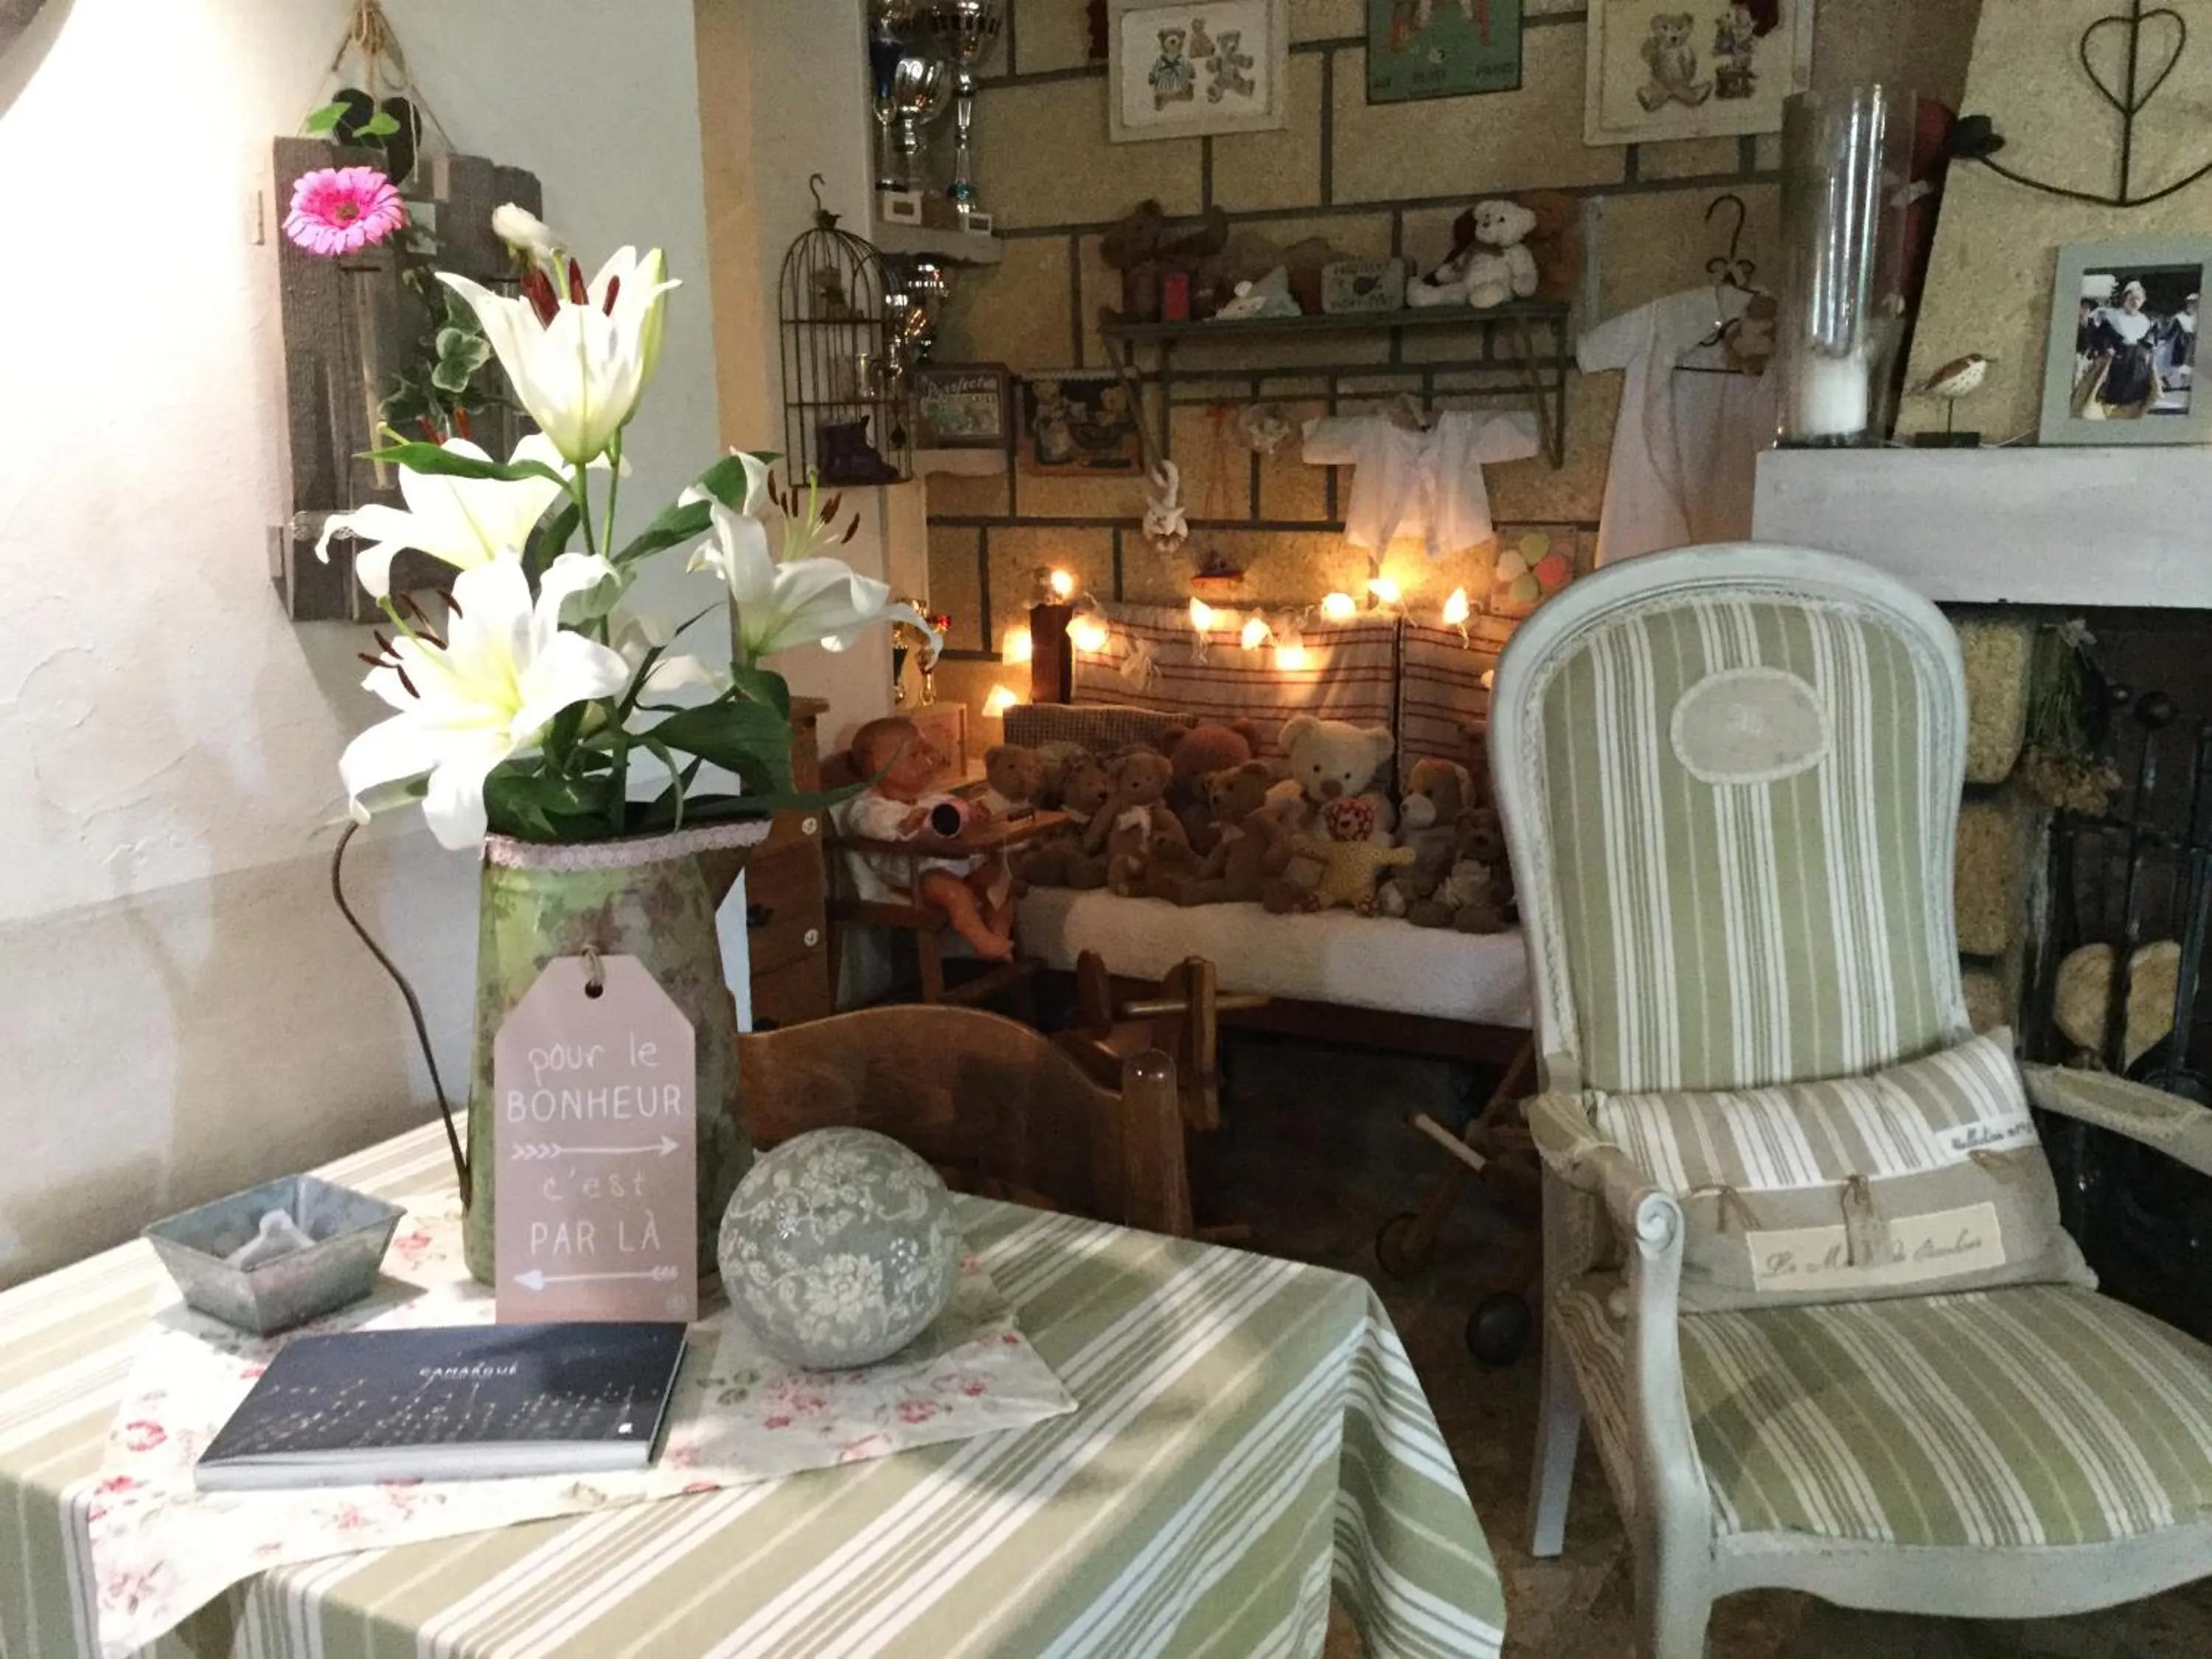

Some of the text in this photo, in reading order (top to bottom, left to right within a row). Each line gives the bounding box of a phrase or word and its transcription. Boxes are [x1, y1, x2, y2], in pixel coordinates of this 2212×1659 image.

[528, 1031, 660, 1086] pour le
[507, 1084, 682, 1122] BONHEUR
[543, 1168, 647, 1201] c'est
[530, 1209, 661, 1255] PAR LÀ
